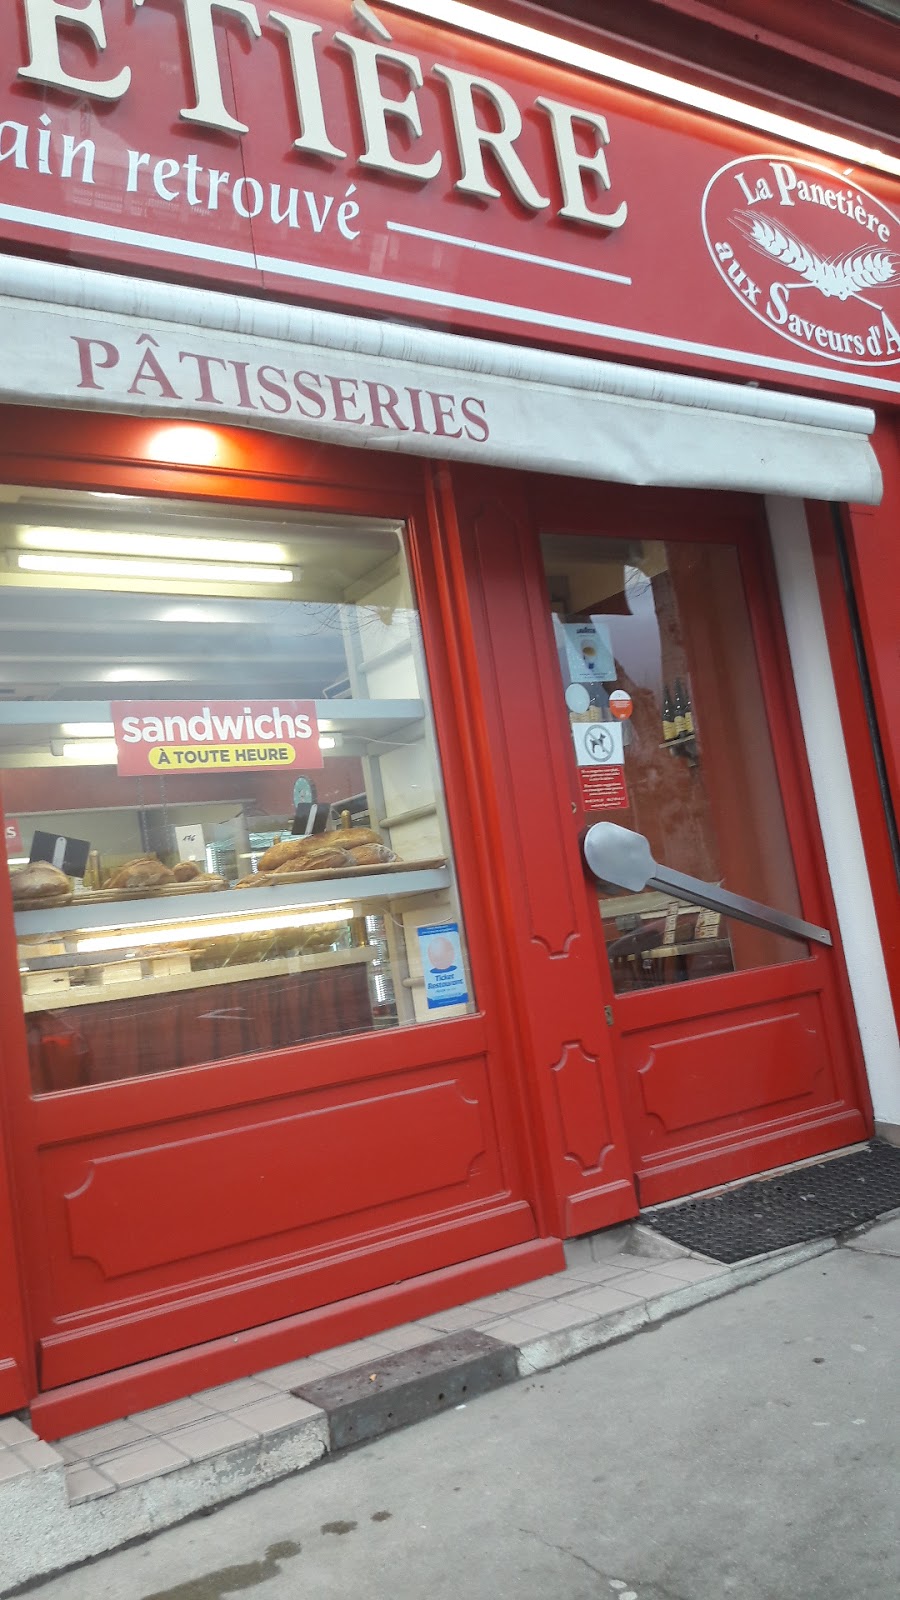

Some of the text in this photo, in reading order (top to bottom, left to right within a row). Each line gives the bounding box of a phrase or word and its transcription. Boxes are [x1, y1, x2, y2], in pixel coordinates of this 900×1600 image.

[0, 113, 360, 240] ain retrouvé
[734, 161, 891, 242] La Panetière
[715, 241, 762, 306] aux
[766, 281, 864, 356] Saveurs
[70, 333, 490, 443] PÂTISSERIES
[121, 706, 312, 743] sandwichs
[157, 748, 289, 764] À TOUTE HEURE
